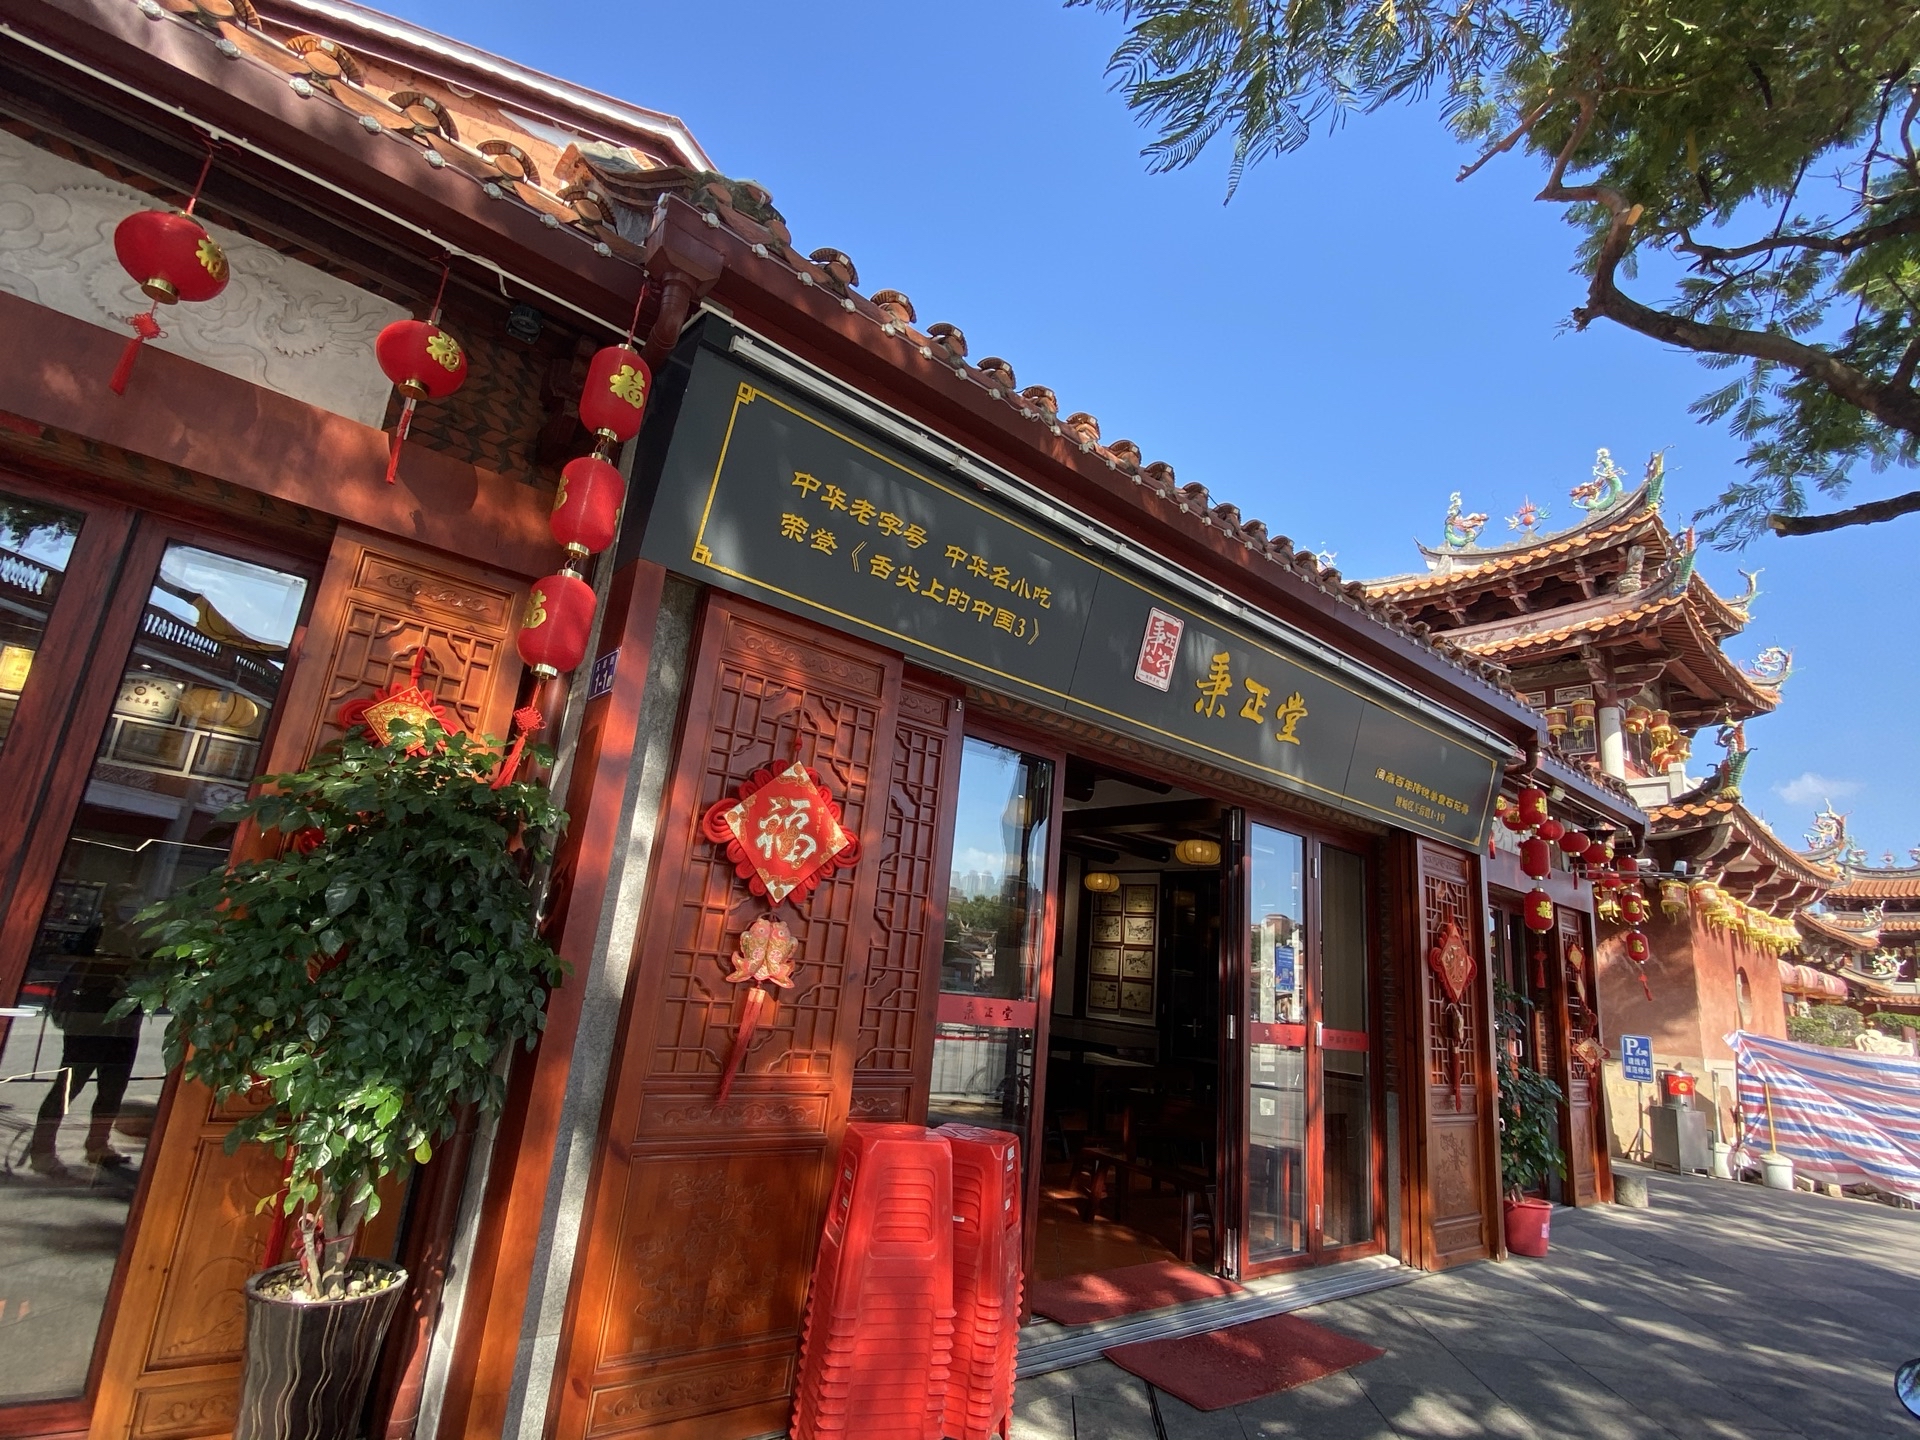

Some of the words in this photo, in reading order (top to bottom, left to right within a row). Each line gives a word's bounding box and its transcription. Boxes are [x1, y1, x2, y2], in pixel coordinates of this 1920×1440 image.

[426, 331, 461, 372] 福
[609, 364, 645, 409] 福
[791, 471, 928, 549] 中华老字号
[944, 544, 1052, 609] 中华名小吃
[1194, 651, 1309, 746] 秉正堂
[756, 796, 817, 869] 福
[1624, 1038, 1639, 1056] P
